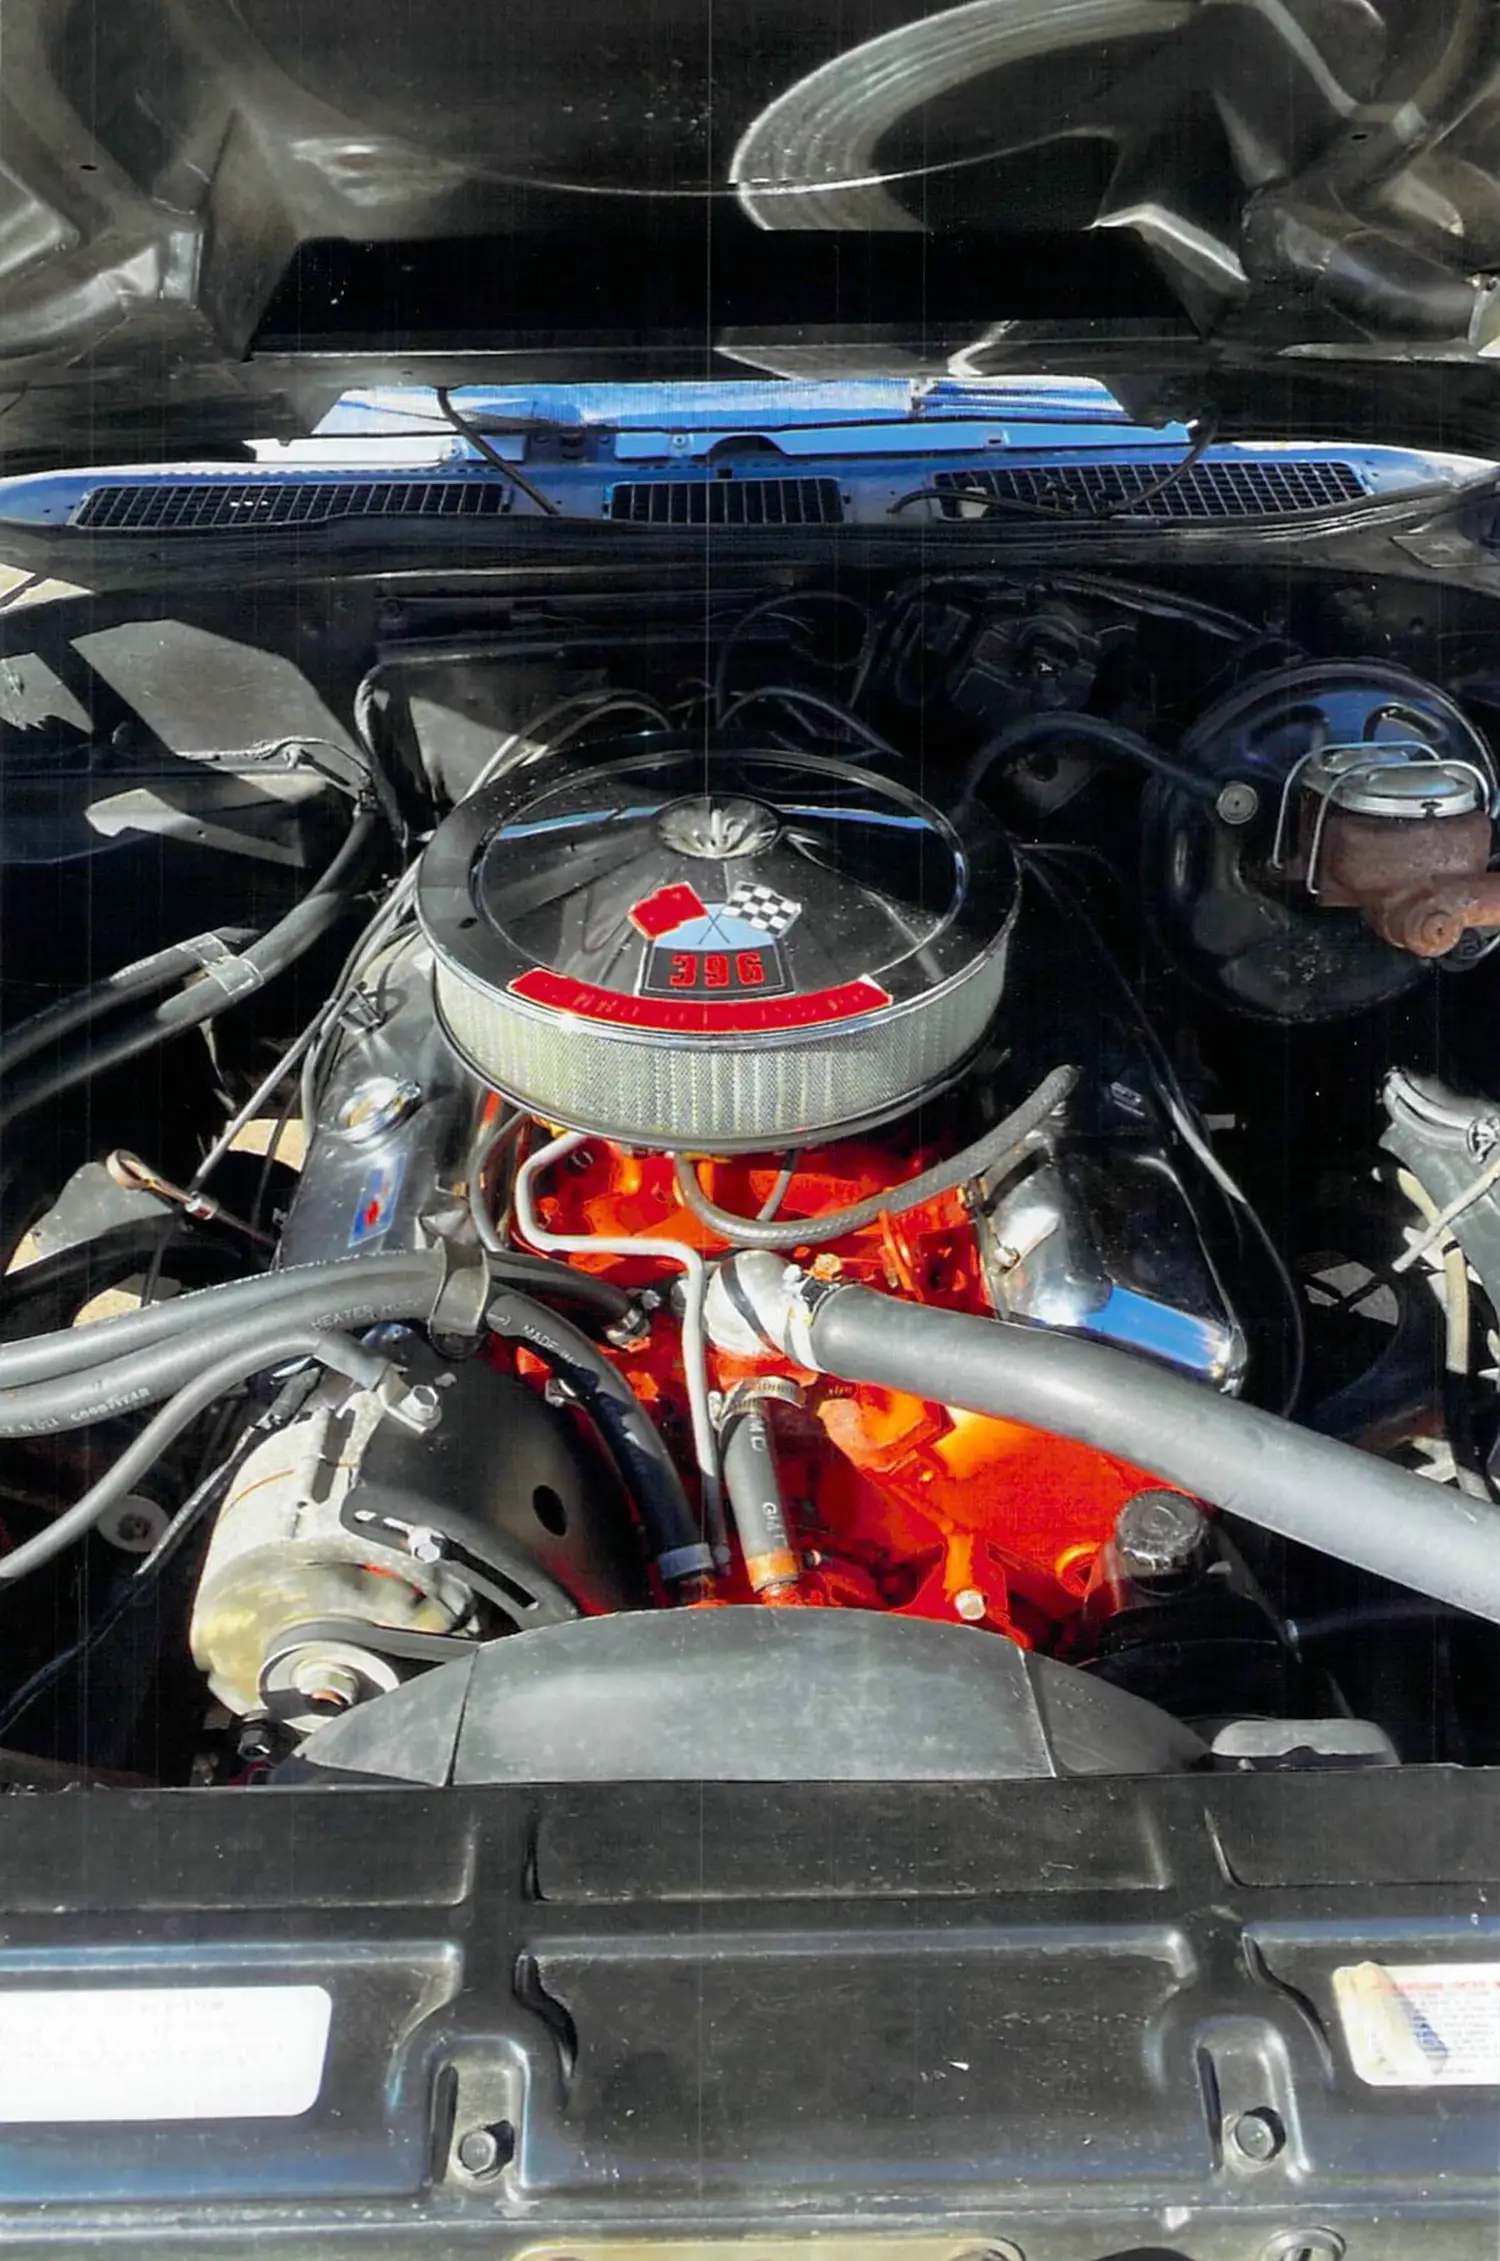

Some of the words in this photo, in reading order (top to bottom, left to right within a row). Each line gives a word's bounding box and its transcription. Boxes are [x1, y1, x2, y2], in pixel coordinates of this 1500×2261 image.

[670, 952, 765, 987] 396
[309, 1304, 375, 1331] HEATER
[522, 1324, 560, 1350] MADE
